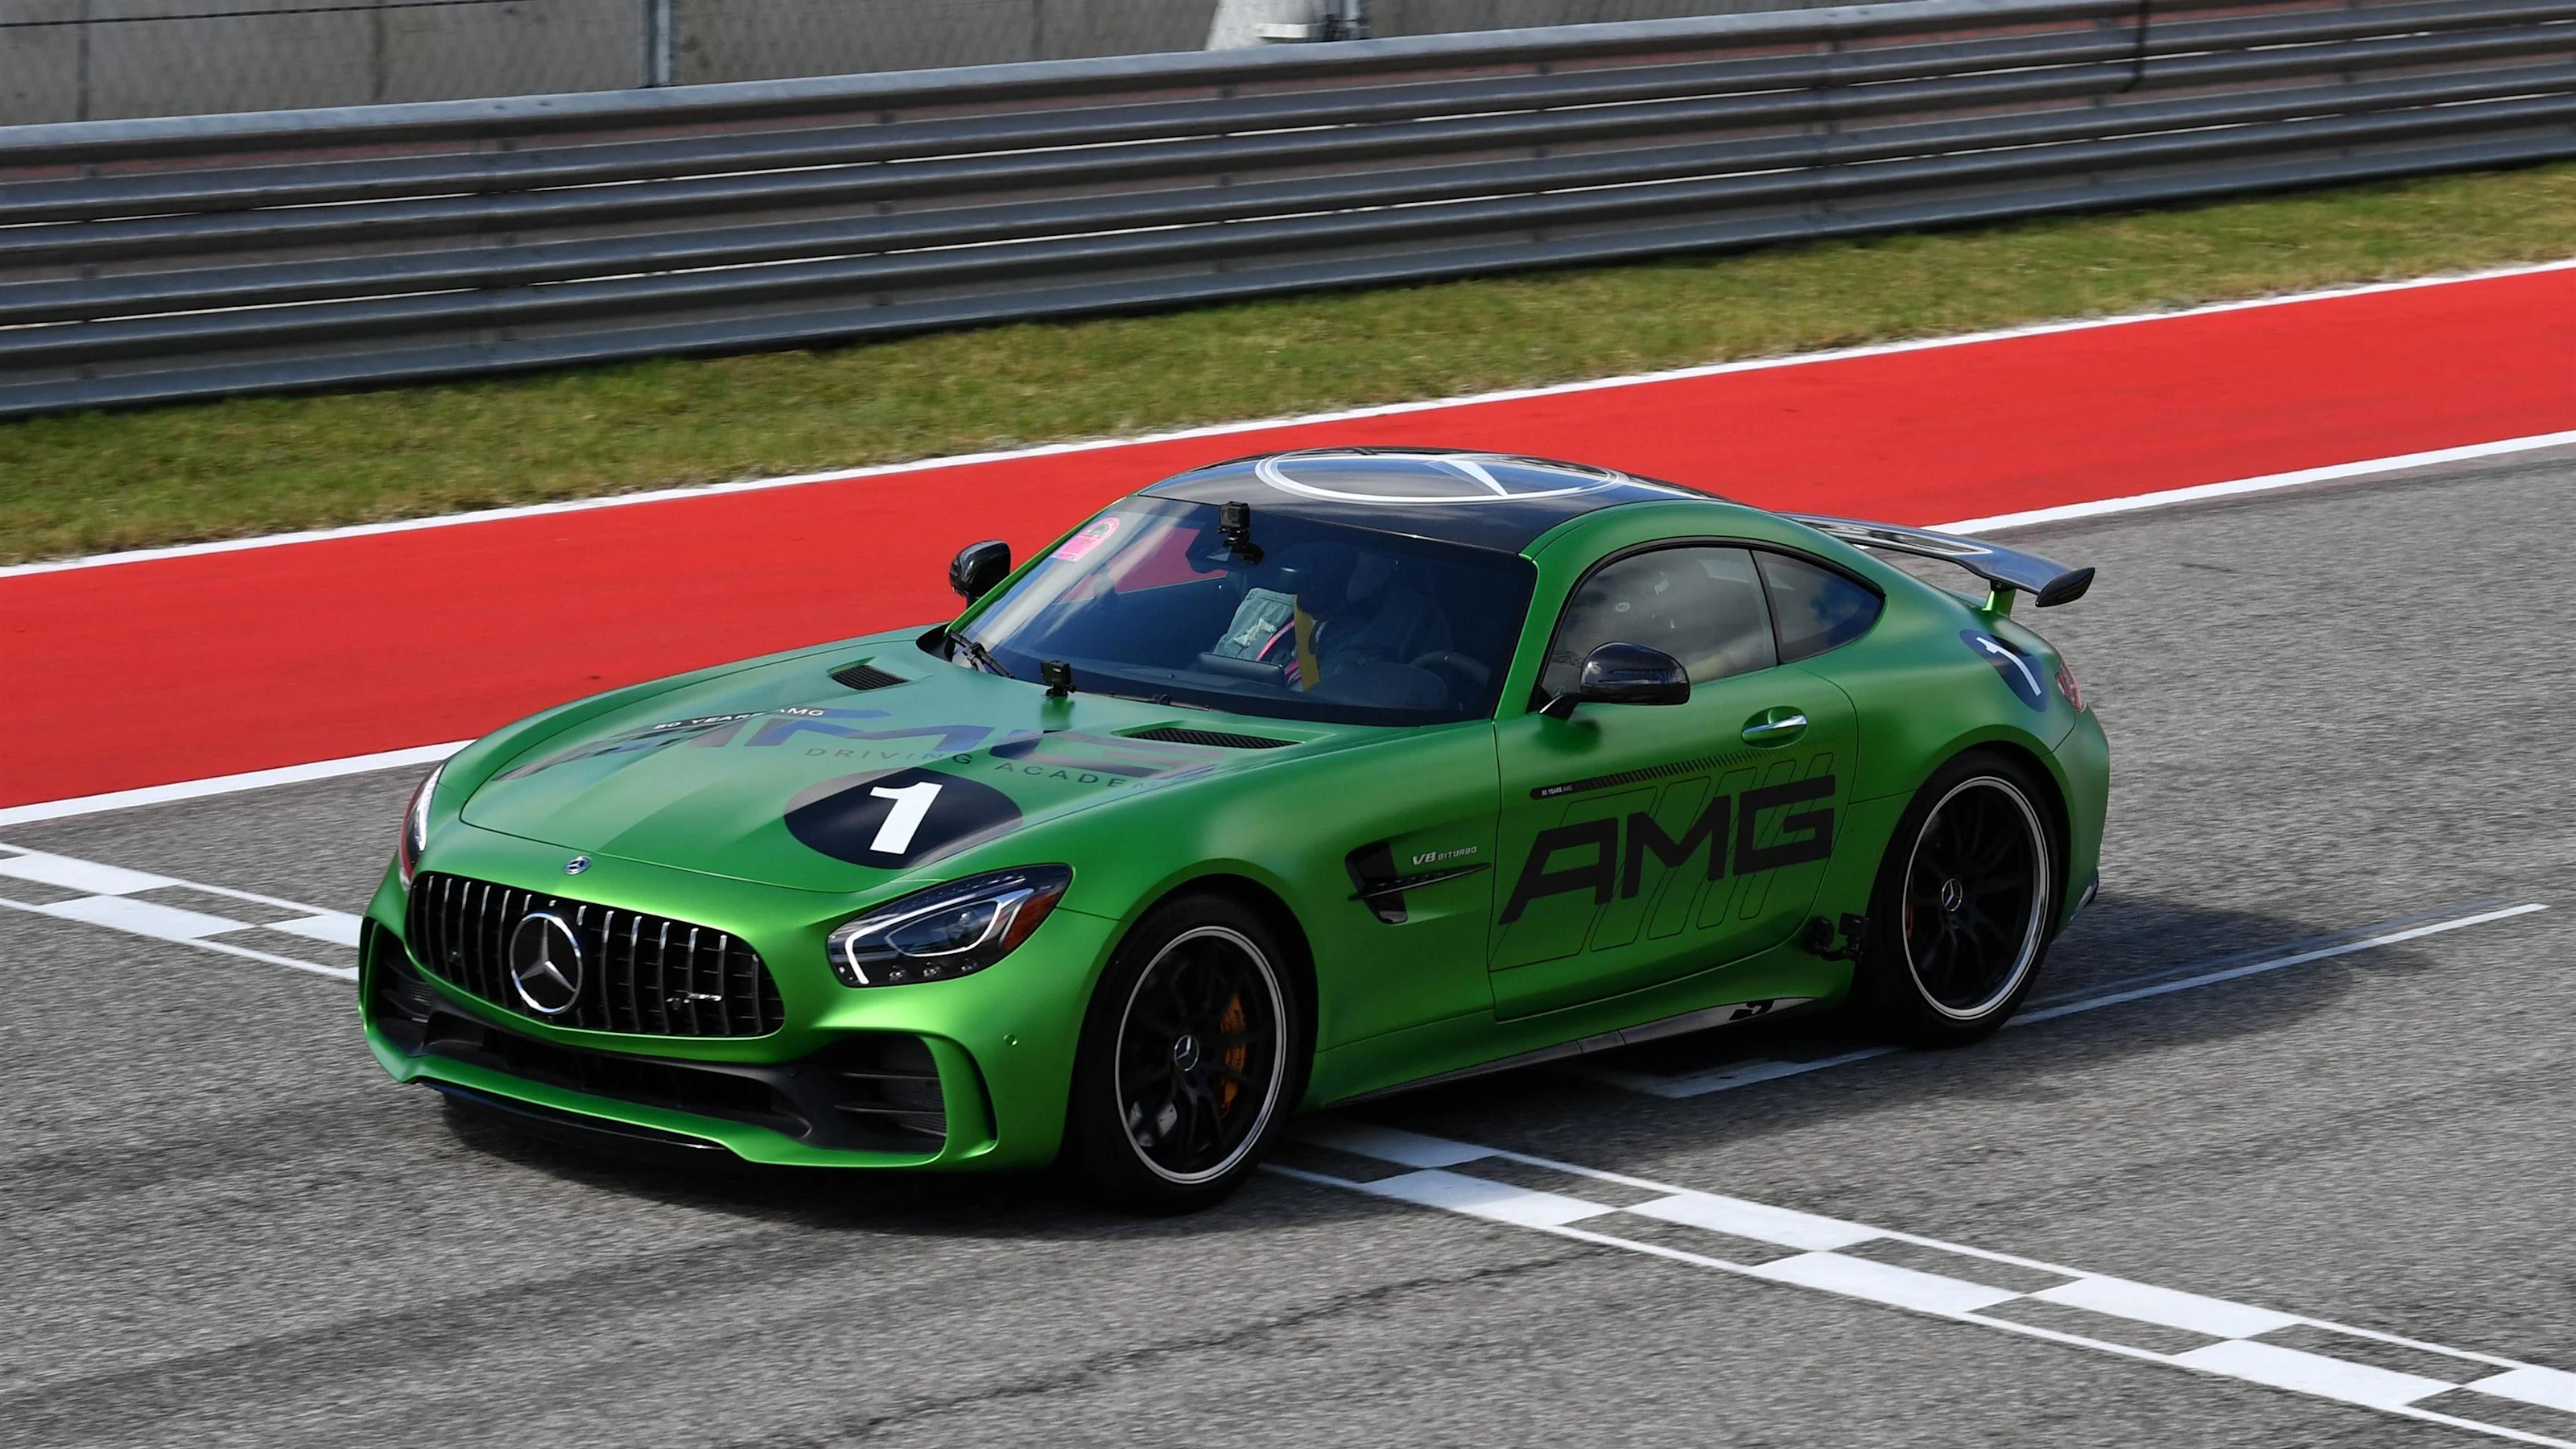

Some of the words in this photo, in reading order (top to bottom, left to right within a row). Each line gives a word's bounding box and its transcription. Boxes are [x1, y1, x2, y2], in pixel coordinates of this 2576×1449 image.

[805, 747, 973, 765] DRIVING
[994, 762, 1158, 789] ACADE
[869, 781, 943, 855] 1
[1413, 851, 1437, 865] V8
[1438, 846, 1478, 861] BITURBO
[1498, 774, 1836, 926] AMG
